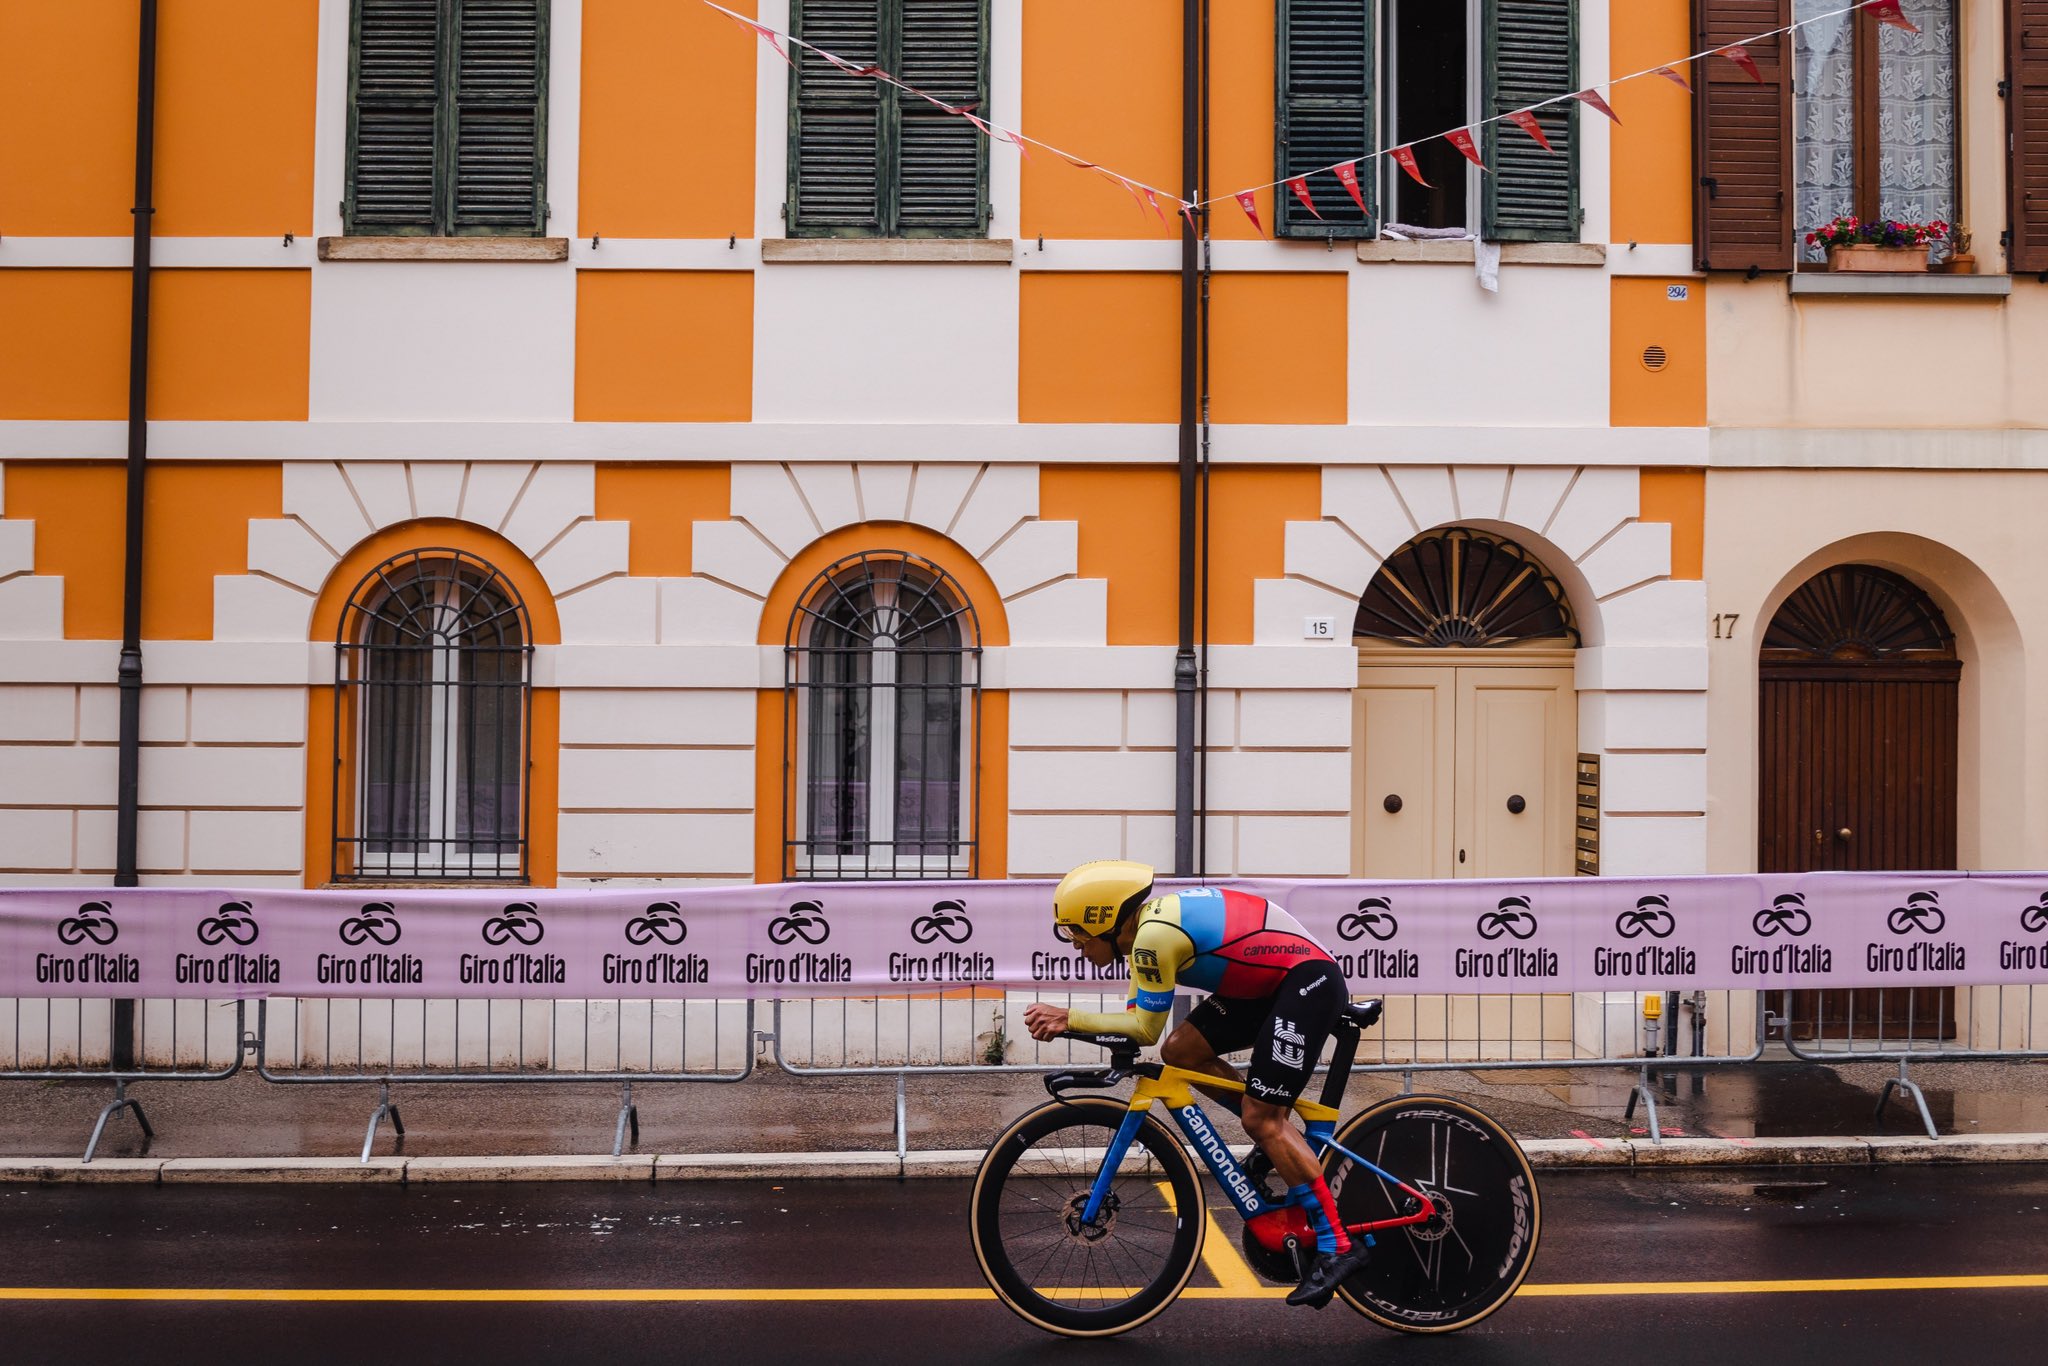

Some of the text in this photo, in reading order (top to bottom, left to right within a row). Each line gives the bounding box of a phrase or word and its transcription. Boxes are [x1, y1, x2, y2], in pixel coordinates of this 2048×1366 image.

[1312, 622, 1327, 635] 15
[1712, 613, 1740, 639] 17
[1083, 905, 1114, 924] EF
[1243, 943, 1311, 957] cannondale
[1357, 949, 1419, 979] d'Italia
[1456, 948, 1559, 978] Giro d'Italia
[1594, 946, 1696, 977] Giro d'Italia
[1732, 944, 1832, 975] Giro d'Italia
[1867, 942, 1966, 972] Giro d'Italia
[2000, 941, 2037, 970] Giro
[36, 953, 140, 984] Giro d'Italia
[176, 953, 281, 984] Giro d'Italia
[317, 953, 423, 984] Giro d'Italia
[460, 953, 566, 984] Giro d'Italia
[603, 953, 709, 984] Giro d'Italia
[746, 953, 852, 983] Giro d'Italia
[889, 952, 995, 982] Giro d'Italia
[1032, 951, 1071, 981] Giro
[1182, 1105, 1259, 1212] cannondale
